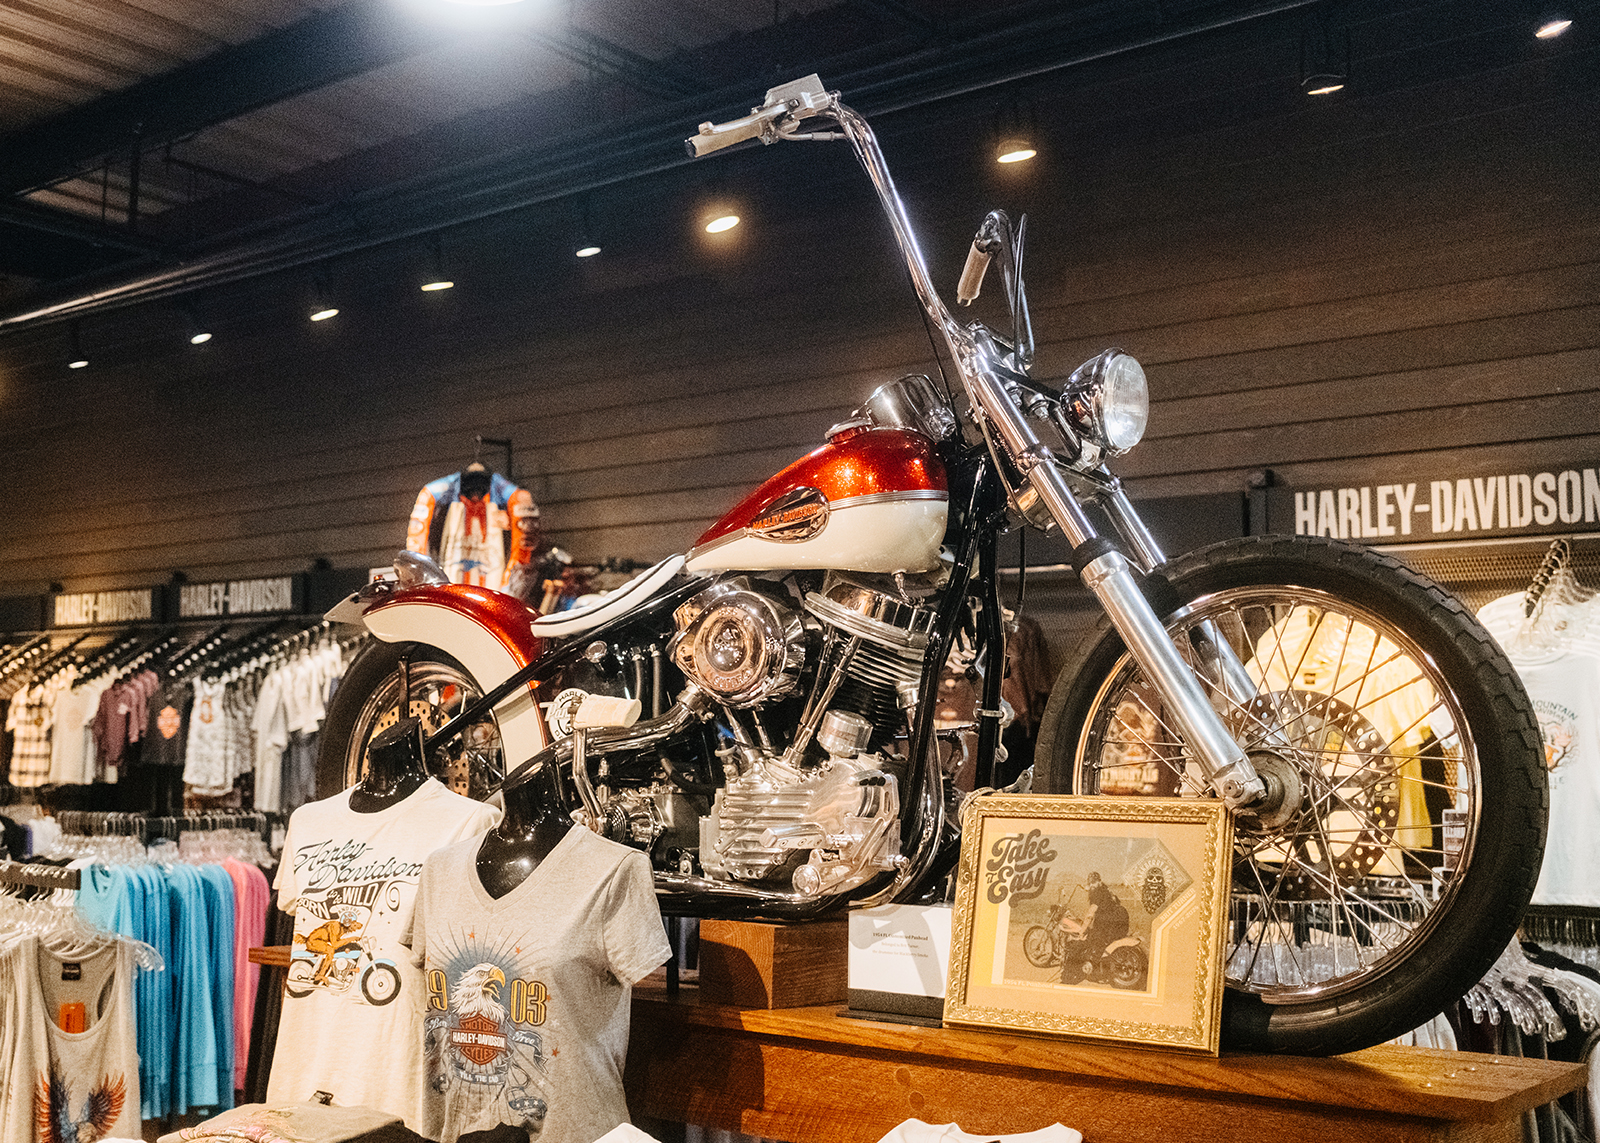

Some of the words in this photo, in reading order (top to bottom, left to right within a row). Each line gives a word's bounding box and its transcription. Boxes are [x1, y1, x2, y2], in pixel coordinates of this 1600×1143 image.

[752, 503, 818, 529] HARLEY-DAVIDSON
[1295, 468, 1600, 539] HARLEY-DAVIDSON
[181, 577, 292, 617] HARLEY-DAVIDSON
[293, 839, 374, 875] Harley-
[986, 828, 1058, 872] Take
[302, 856, 423, 896] Davidson
[342, 882, 380, 906] WILD
[987, 865, 1051, 908] Easy
[1160, 908, 1174, 922] BRIT
[1172, 887, 1196, 910] TURNER
[425, 969, 448, 1012] 9
[510, 978, 548, 1026] 03
[452, 1031, 505, 1048] HARLEY-DAVIDSON
[464, 1020, 496, 1032] MOTOR
[465, 1046, 497, 1060] CYCLES
